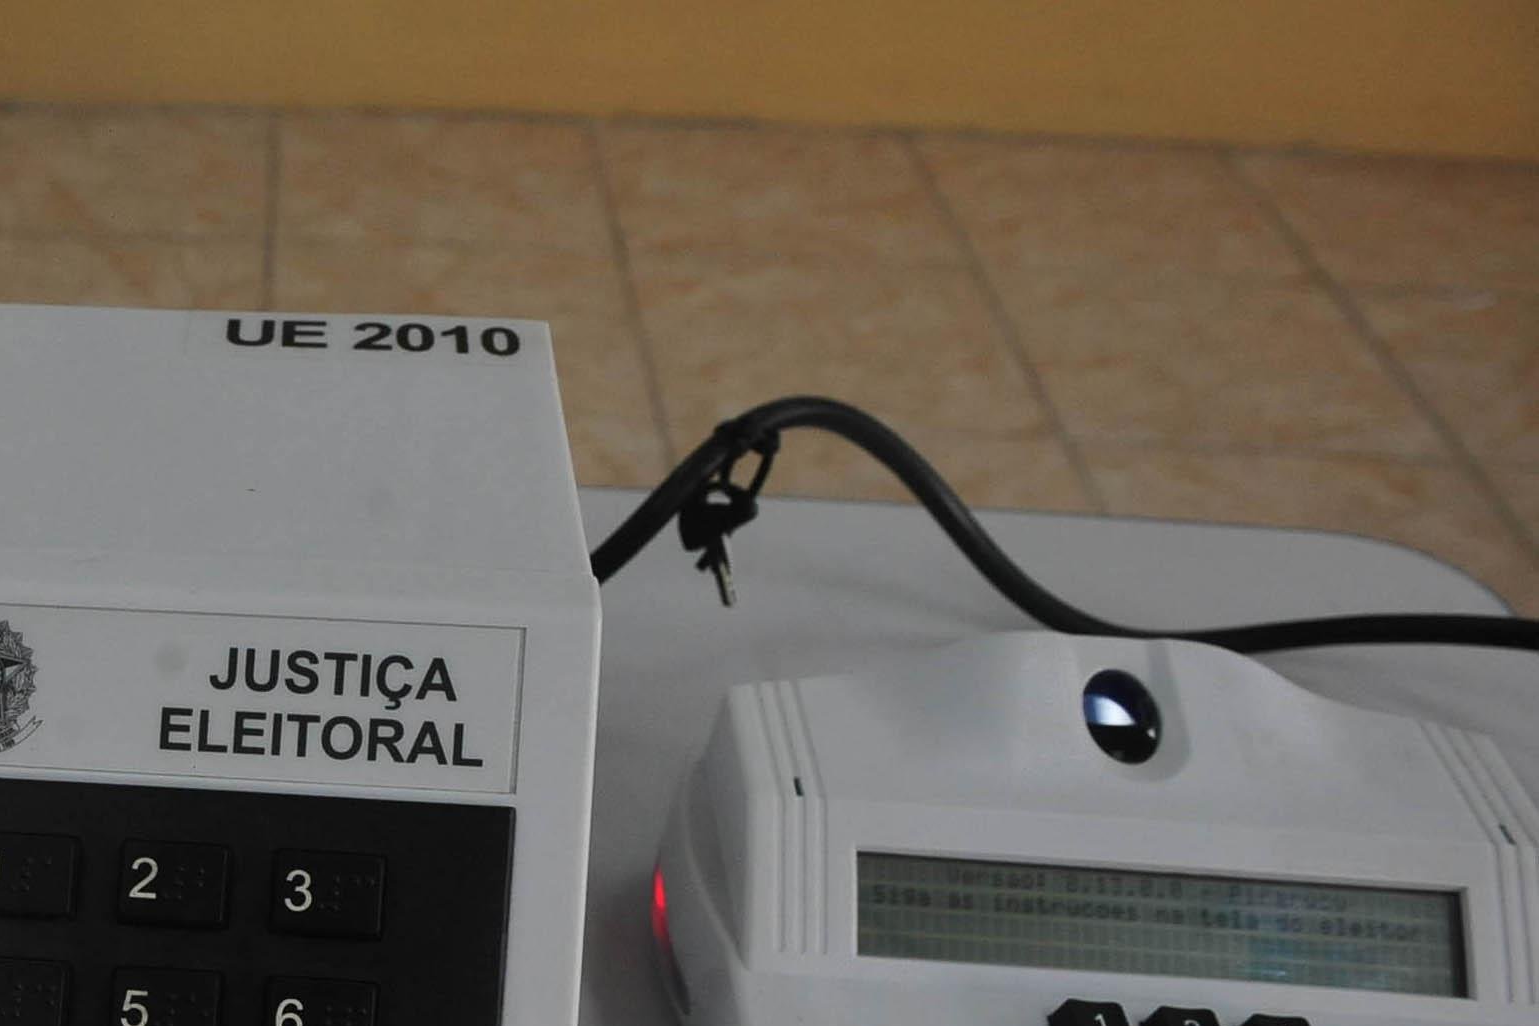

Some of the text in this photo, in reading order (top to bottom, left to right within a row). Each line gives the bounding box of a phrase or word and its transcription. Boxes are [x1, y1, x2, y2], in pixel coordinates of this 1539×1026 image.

[227, 319, 521, 357] UE 2010
[209, 647, 457, 711] JUSTIÇA
[159, 706, 484, 768] ELEITORAL
[128, 857, 158, 899] 2
[284, 869, 313, 912] 3
